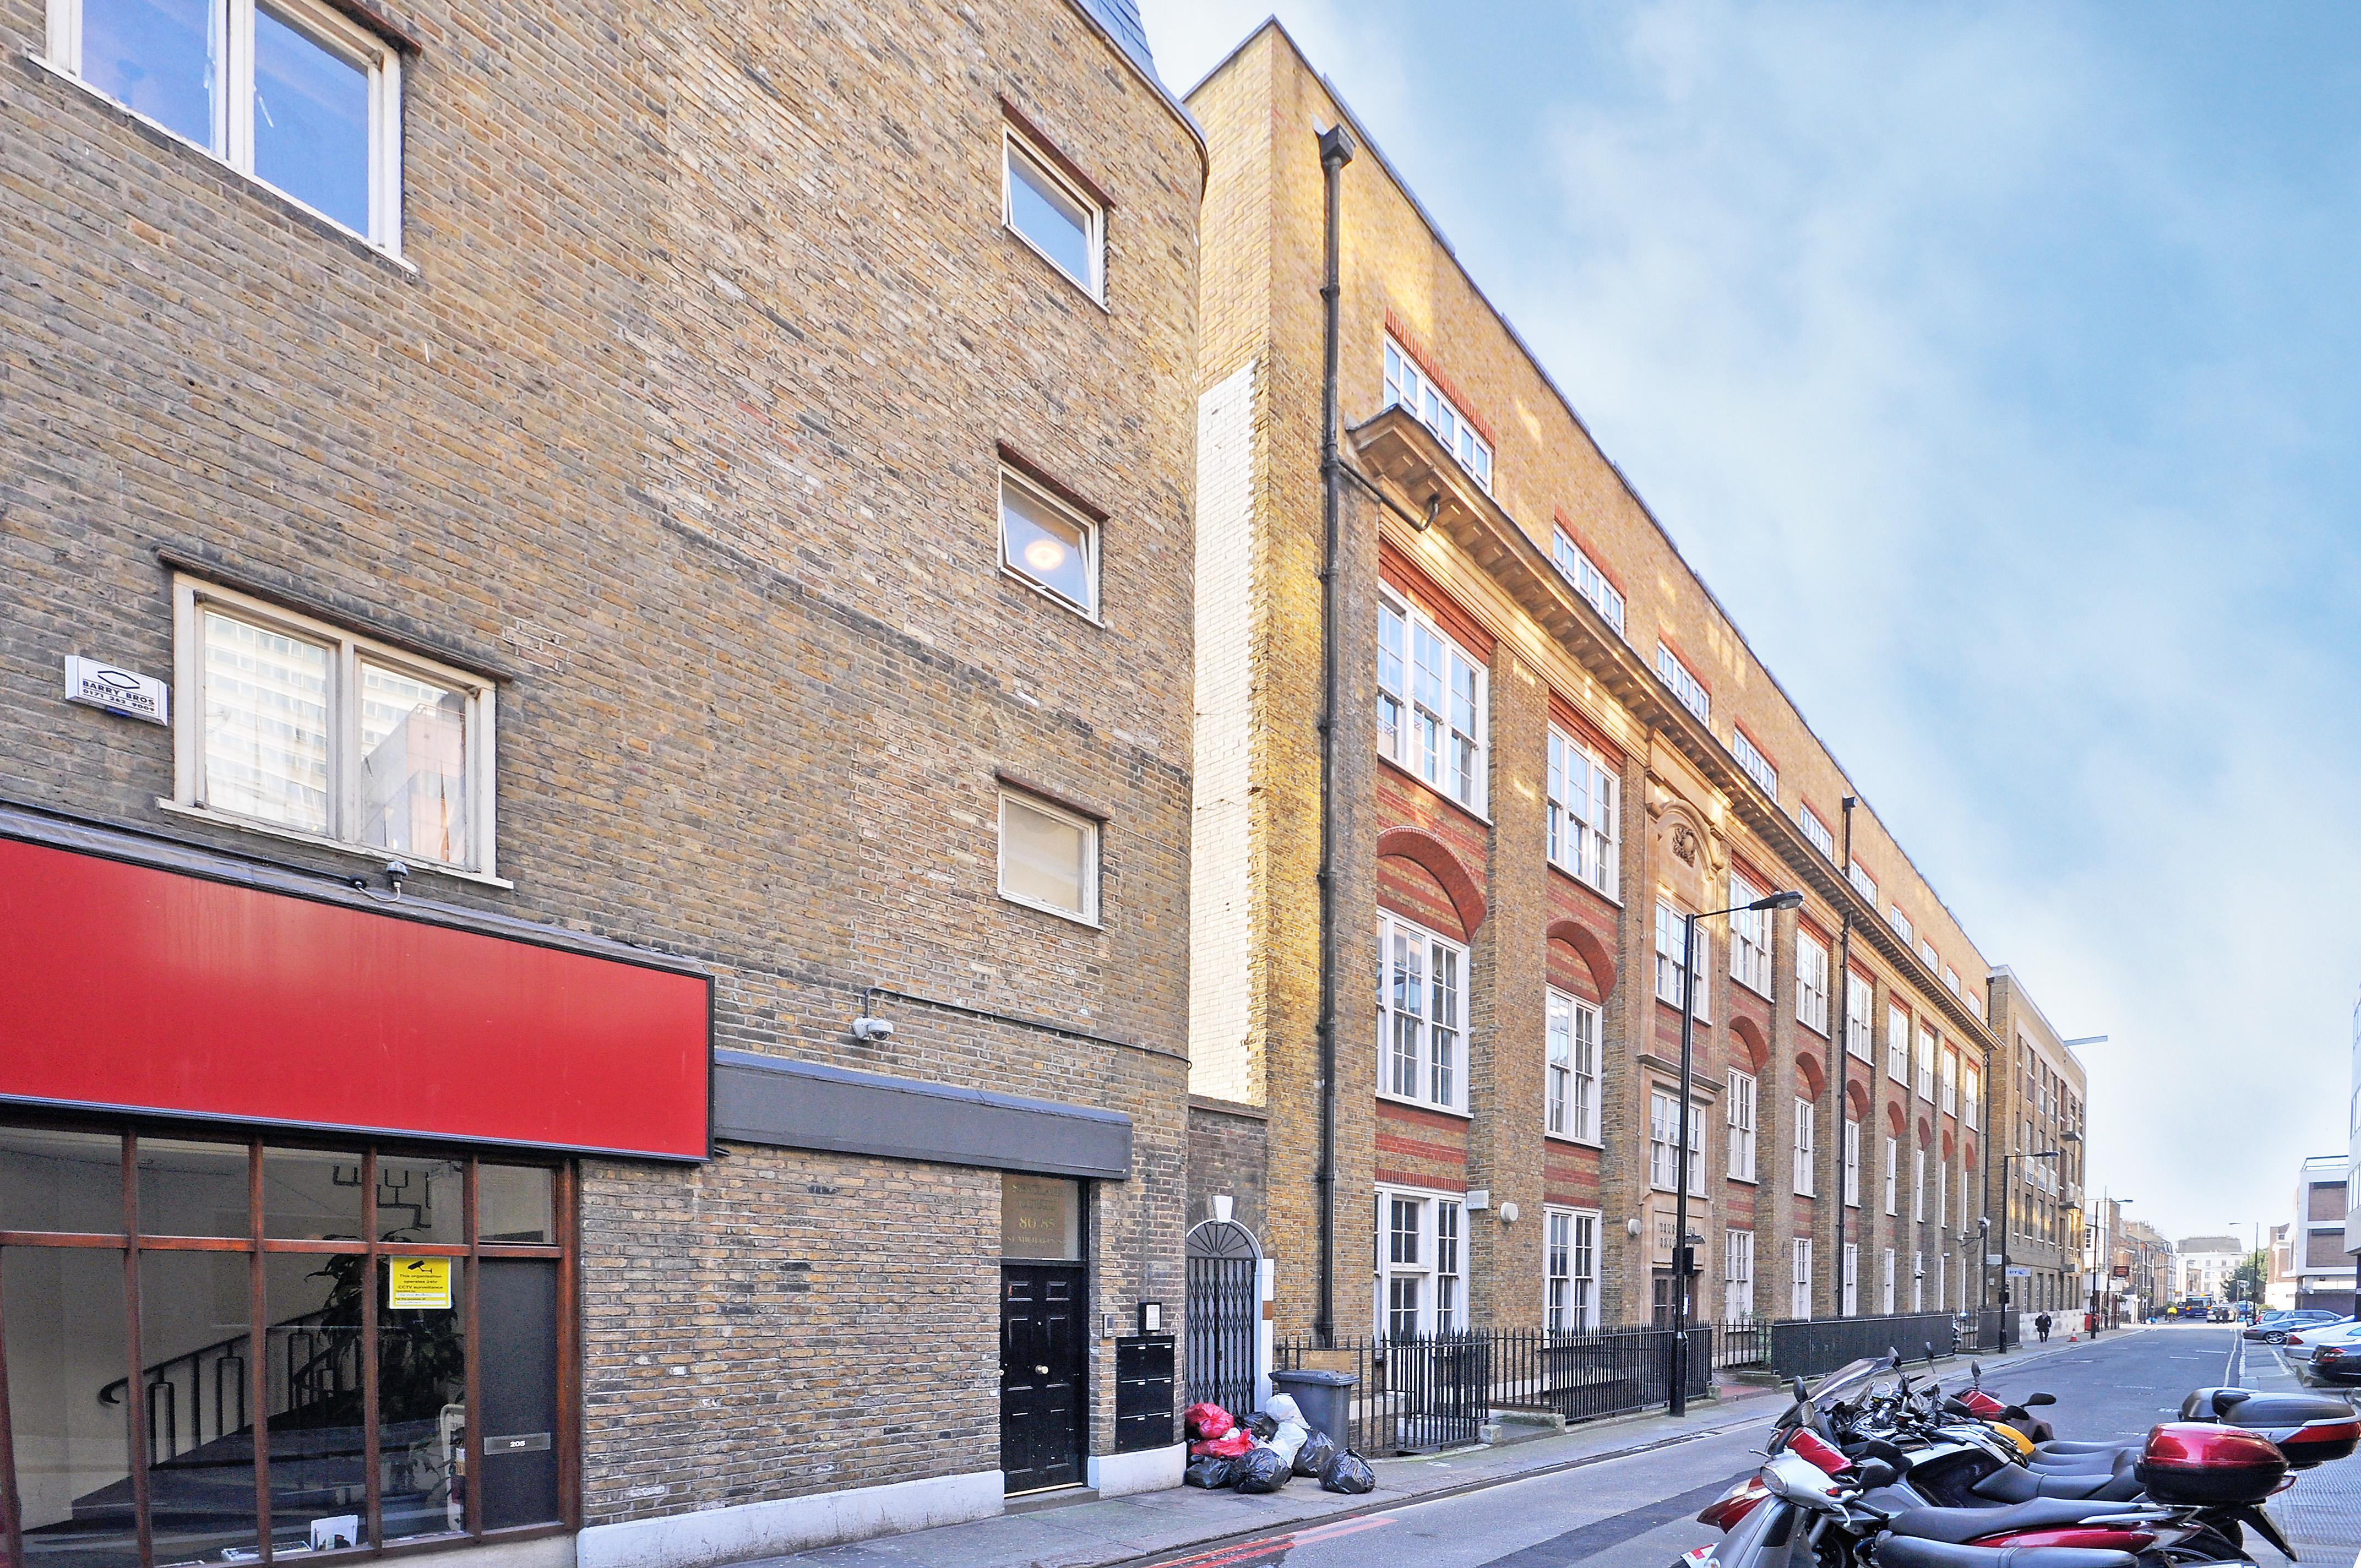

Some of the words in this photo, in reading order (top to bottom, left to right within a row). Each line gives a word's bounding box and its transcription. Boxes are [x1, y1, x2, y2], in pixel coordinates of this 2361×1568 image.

[83, 680, 120, 695] BARRY
[126, 693, 155, 705] BROS
[83, 689, 104, 698] 0171
[110, 696, 126, 704] 262
[132, 702, 155, 711] 9009
[1019, 1216, 1036, 1229] 80
